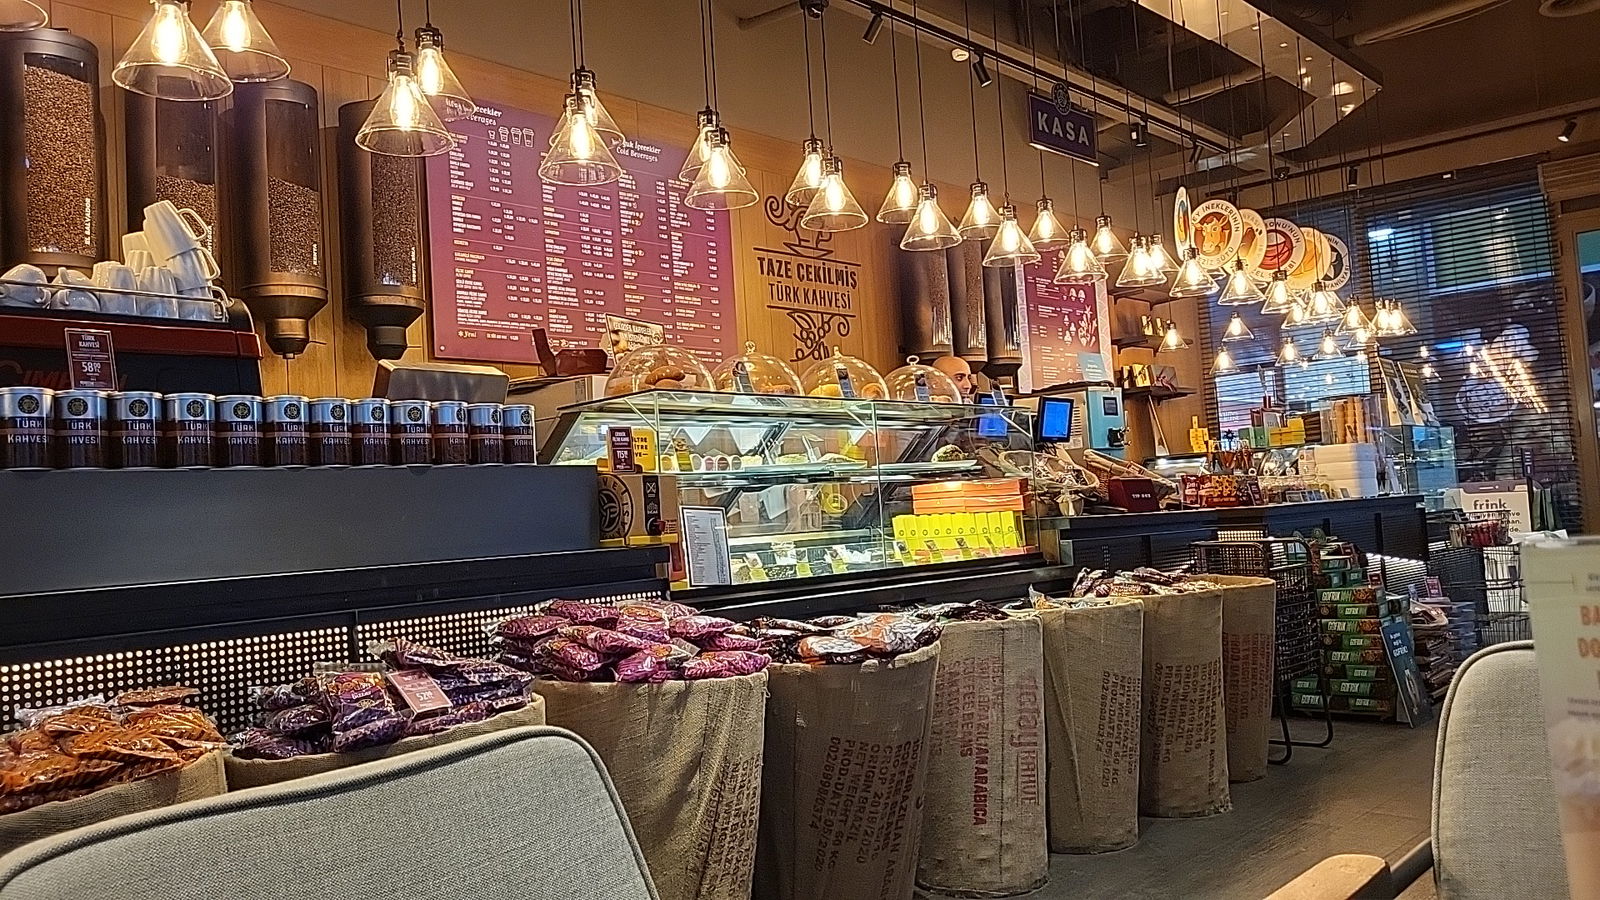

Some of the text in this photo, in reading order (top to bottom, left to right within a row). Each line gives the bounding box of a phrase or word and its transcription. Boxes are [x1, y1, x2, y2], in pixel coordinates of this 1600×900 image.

[1037, 111, 1089, 147] KASA
[757, 256, 792, 279] TAZE
[768, 281, 852, 310] TÜRK KAHVESİ
[81, 361, 93, 373] 58
[1473, 498, 1508, 510] frink
[853, 741, 869, 770] NET
[877, 745, 893, 785] CROP
[826, 739, 856, 817] PROD.DATE
[846, 743, 881, 843] ORIGIN BRAZIL
[973, 766, 989, 826] ARABICA
